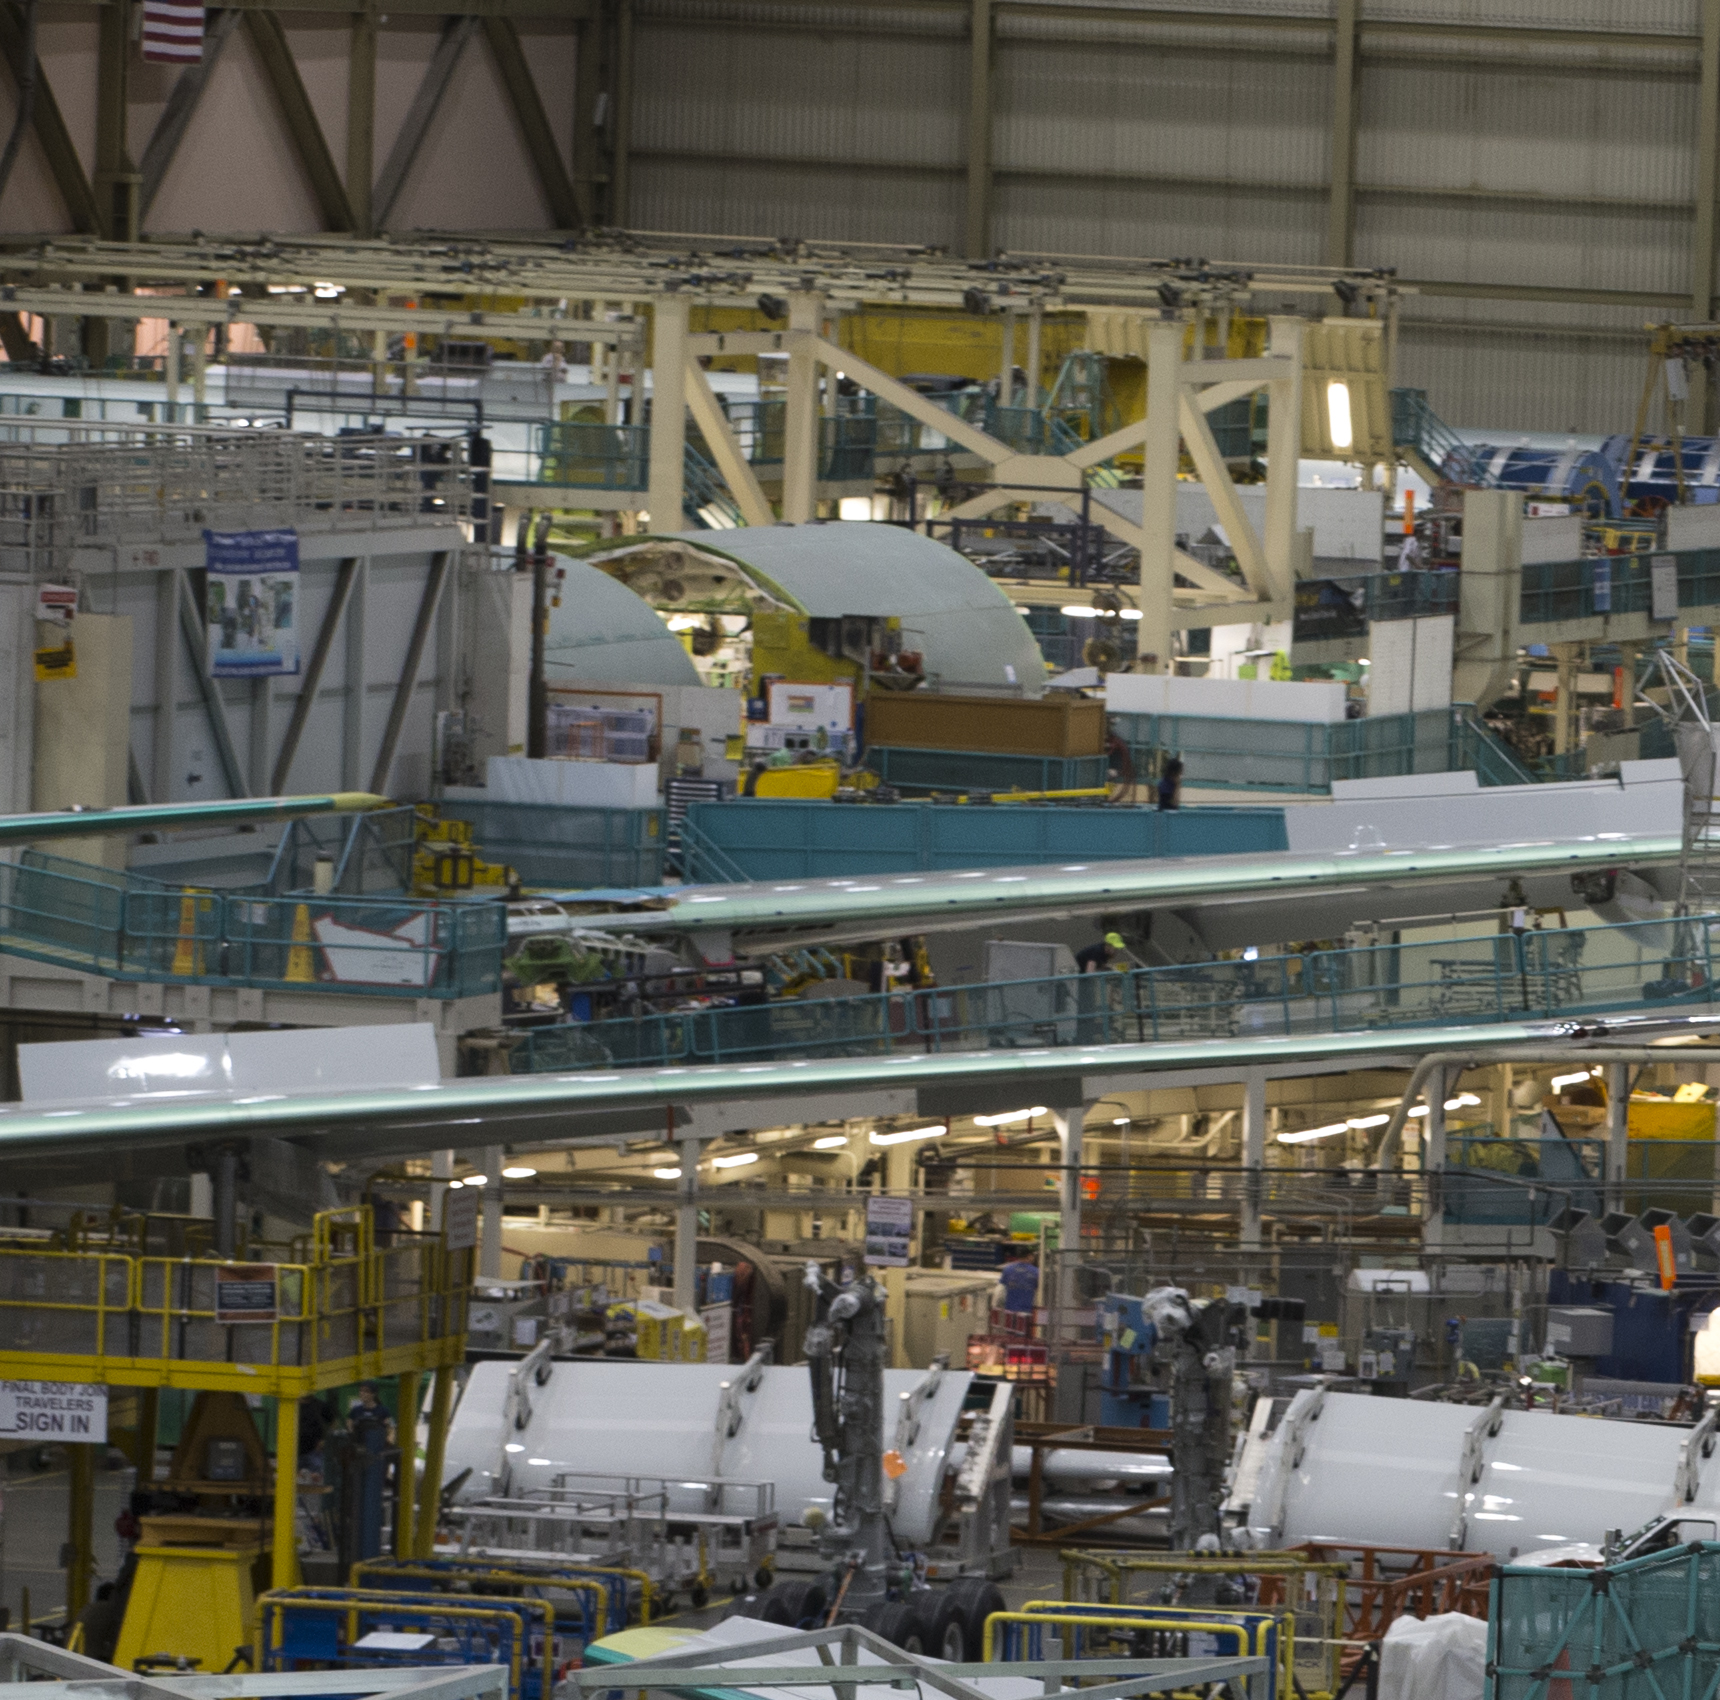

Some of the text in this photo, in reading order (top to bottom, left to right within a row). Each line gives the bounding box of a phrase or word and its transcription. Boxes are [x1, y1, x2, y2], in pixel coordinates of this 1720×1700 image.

[40, 1382, 76, 1396] BODY
[15, 1395, 95, 1412] TRAVELERS
[15, 1411, 90, 1433] SIGN IN
